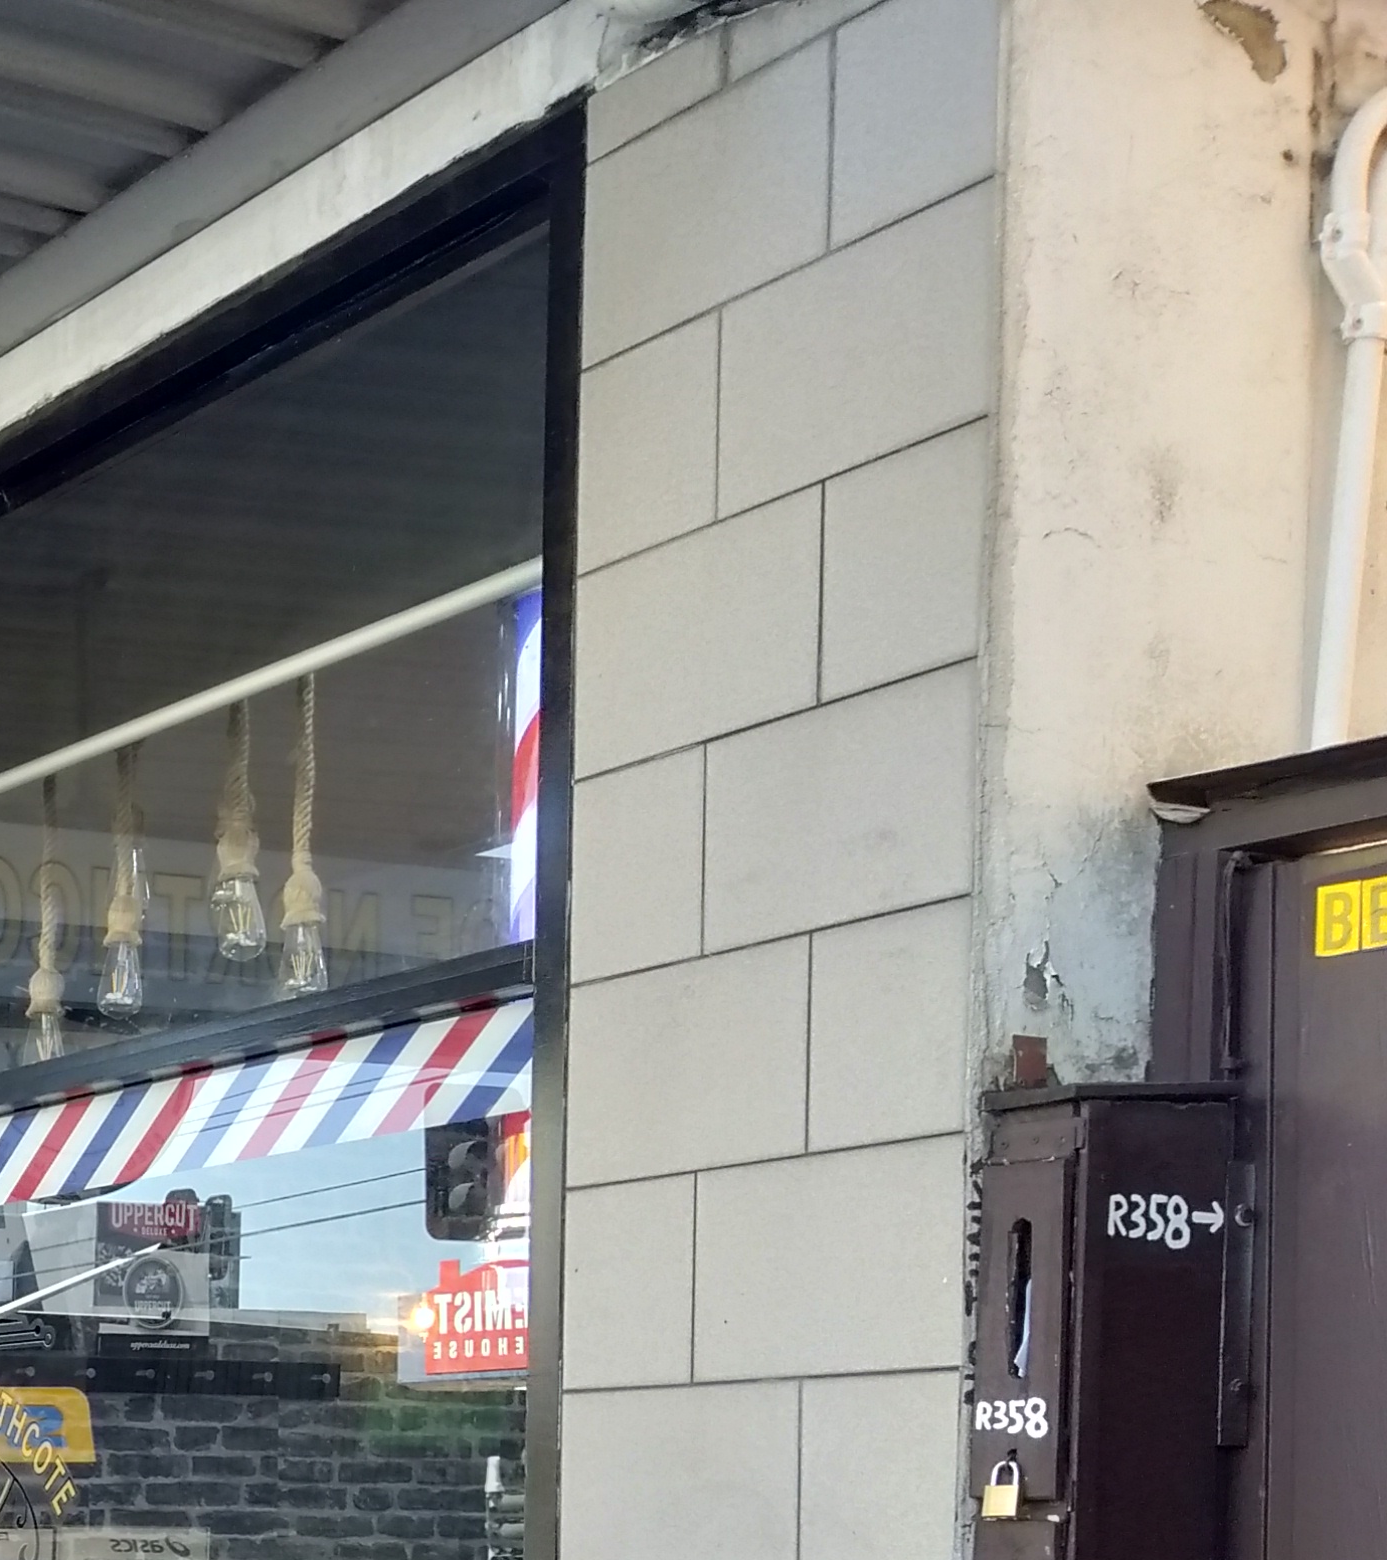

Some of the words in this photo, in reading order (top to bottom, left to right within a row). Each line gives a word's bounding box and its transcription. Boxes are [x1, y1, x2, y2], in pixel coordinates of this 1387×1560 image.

[111, 1202, 198, 1232] UPPERCUT
[1107, 1194, 1190, 1249] R358
[975, 1397, 1048, 1439] R358
